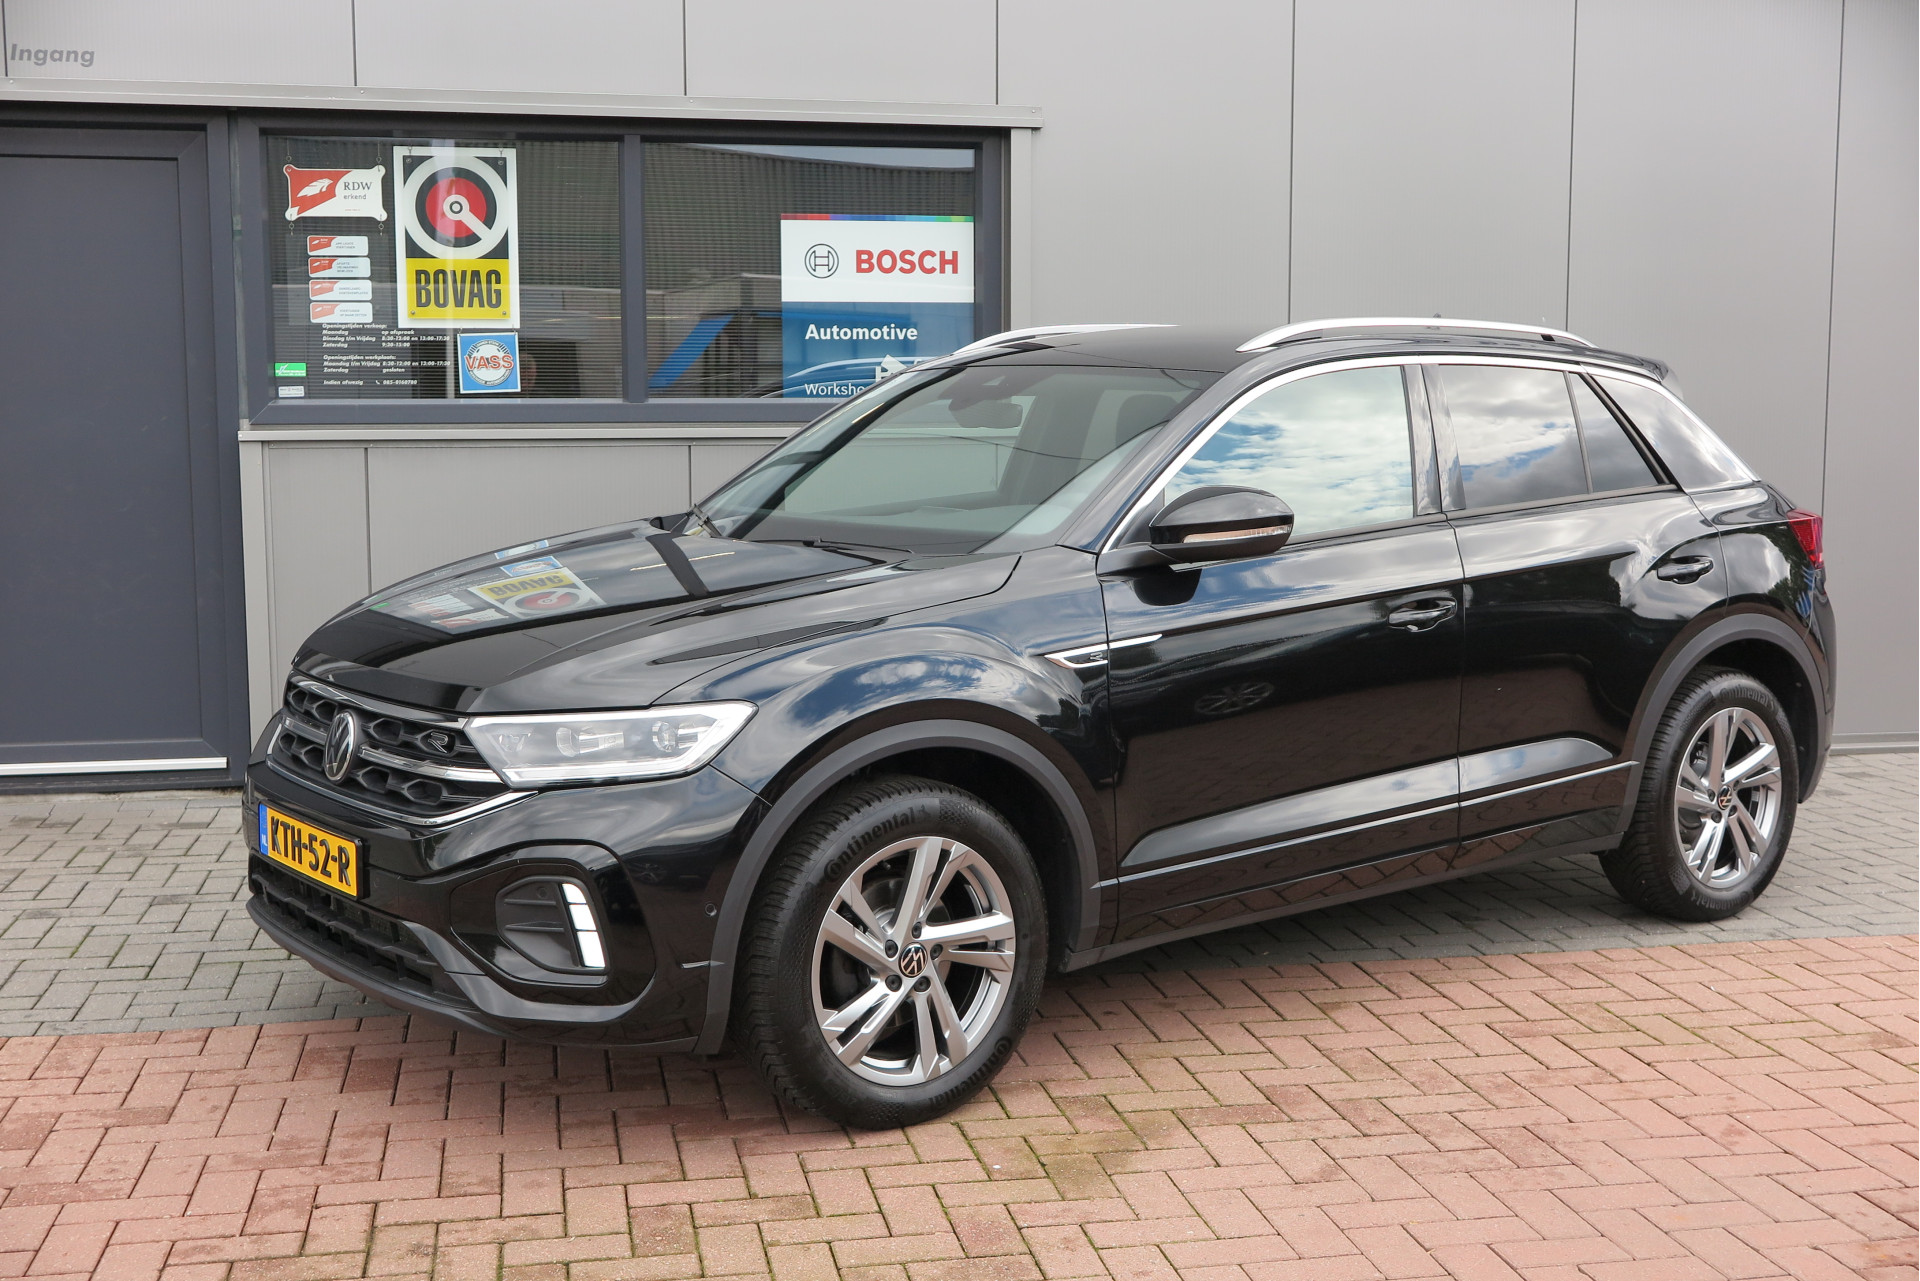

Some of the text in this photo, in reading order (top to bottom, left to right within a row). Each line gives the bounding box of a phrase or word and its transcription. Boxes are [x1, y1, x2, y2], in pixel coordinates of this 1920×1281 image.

[10, 43, 95, 68] Ingang
[343, 181, 372, 191] RDW
[855, 249, 959, 275] BOSCH
[415, 269, 502, 309] BOVAG
[804, 323, 918, 340] Automotive
[464, 354, 514, 370] VASS
[804, 383, 866, 395] Worksho
[270, 815, 351, 887] KTH-52-R
[823, 806, 917, 881] Continental
